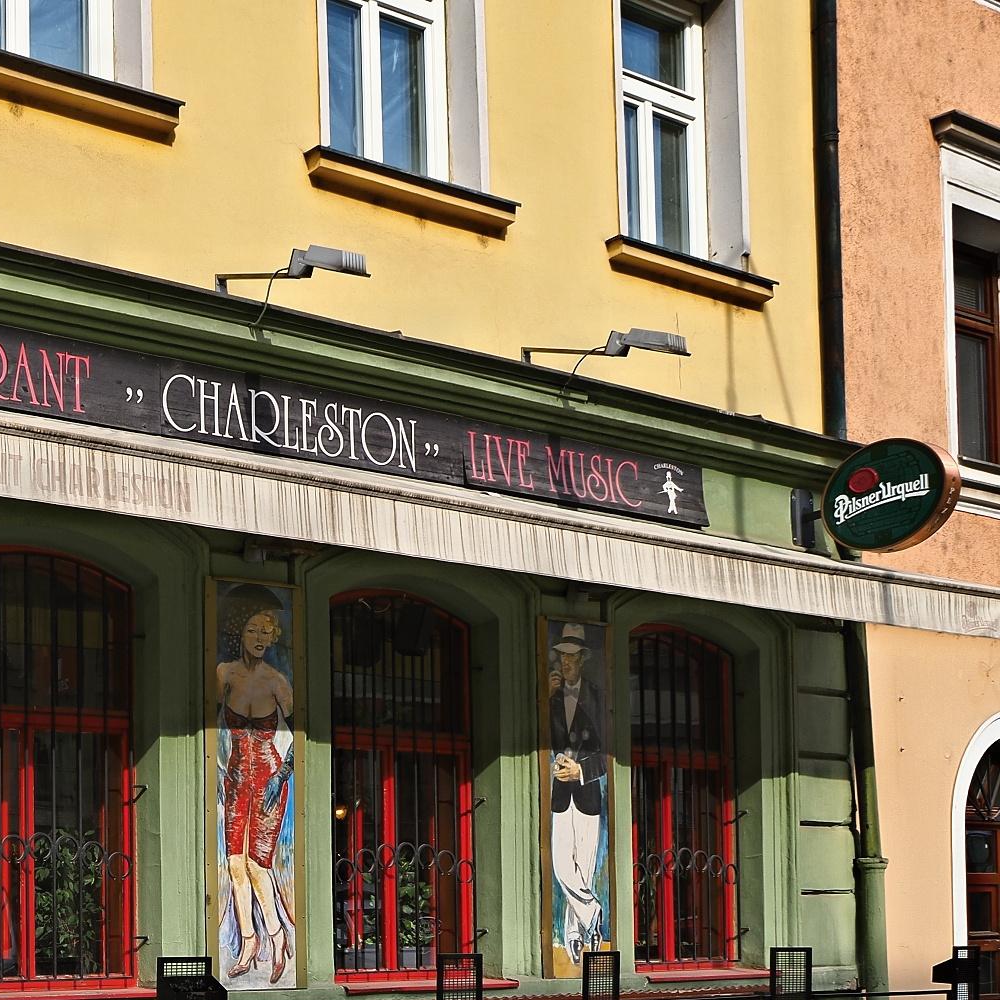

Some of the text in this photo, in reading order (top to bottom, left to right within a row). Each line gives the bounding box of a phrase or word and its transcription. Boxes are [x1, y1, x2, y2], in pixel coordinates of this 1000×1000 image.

[467, 431, 534, 491] LIVE
[545, 446, 642, 507] MUSIC
[834, 474, 930, 525] Pilsner Urquell
